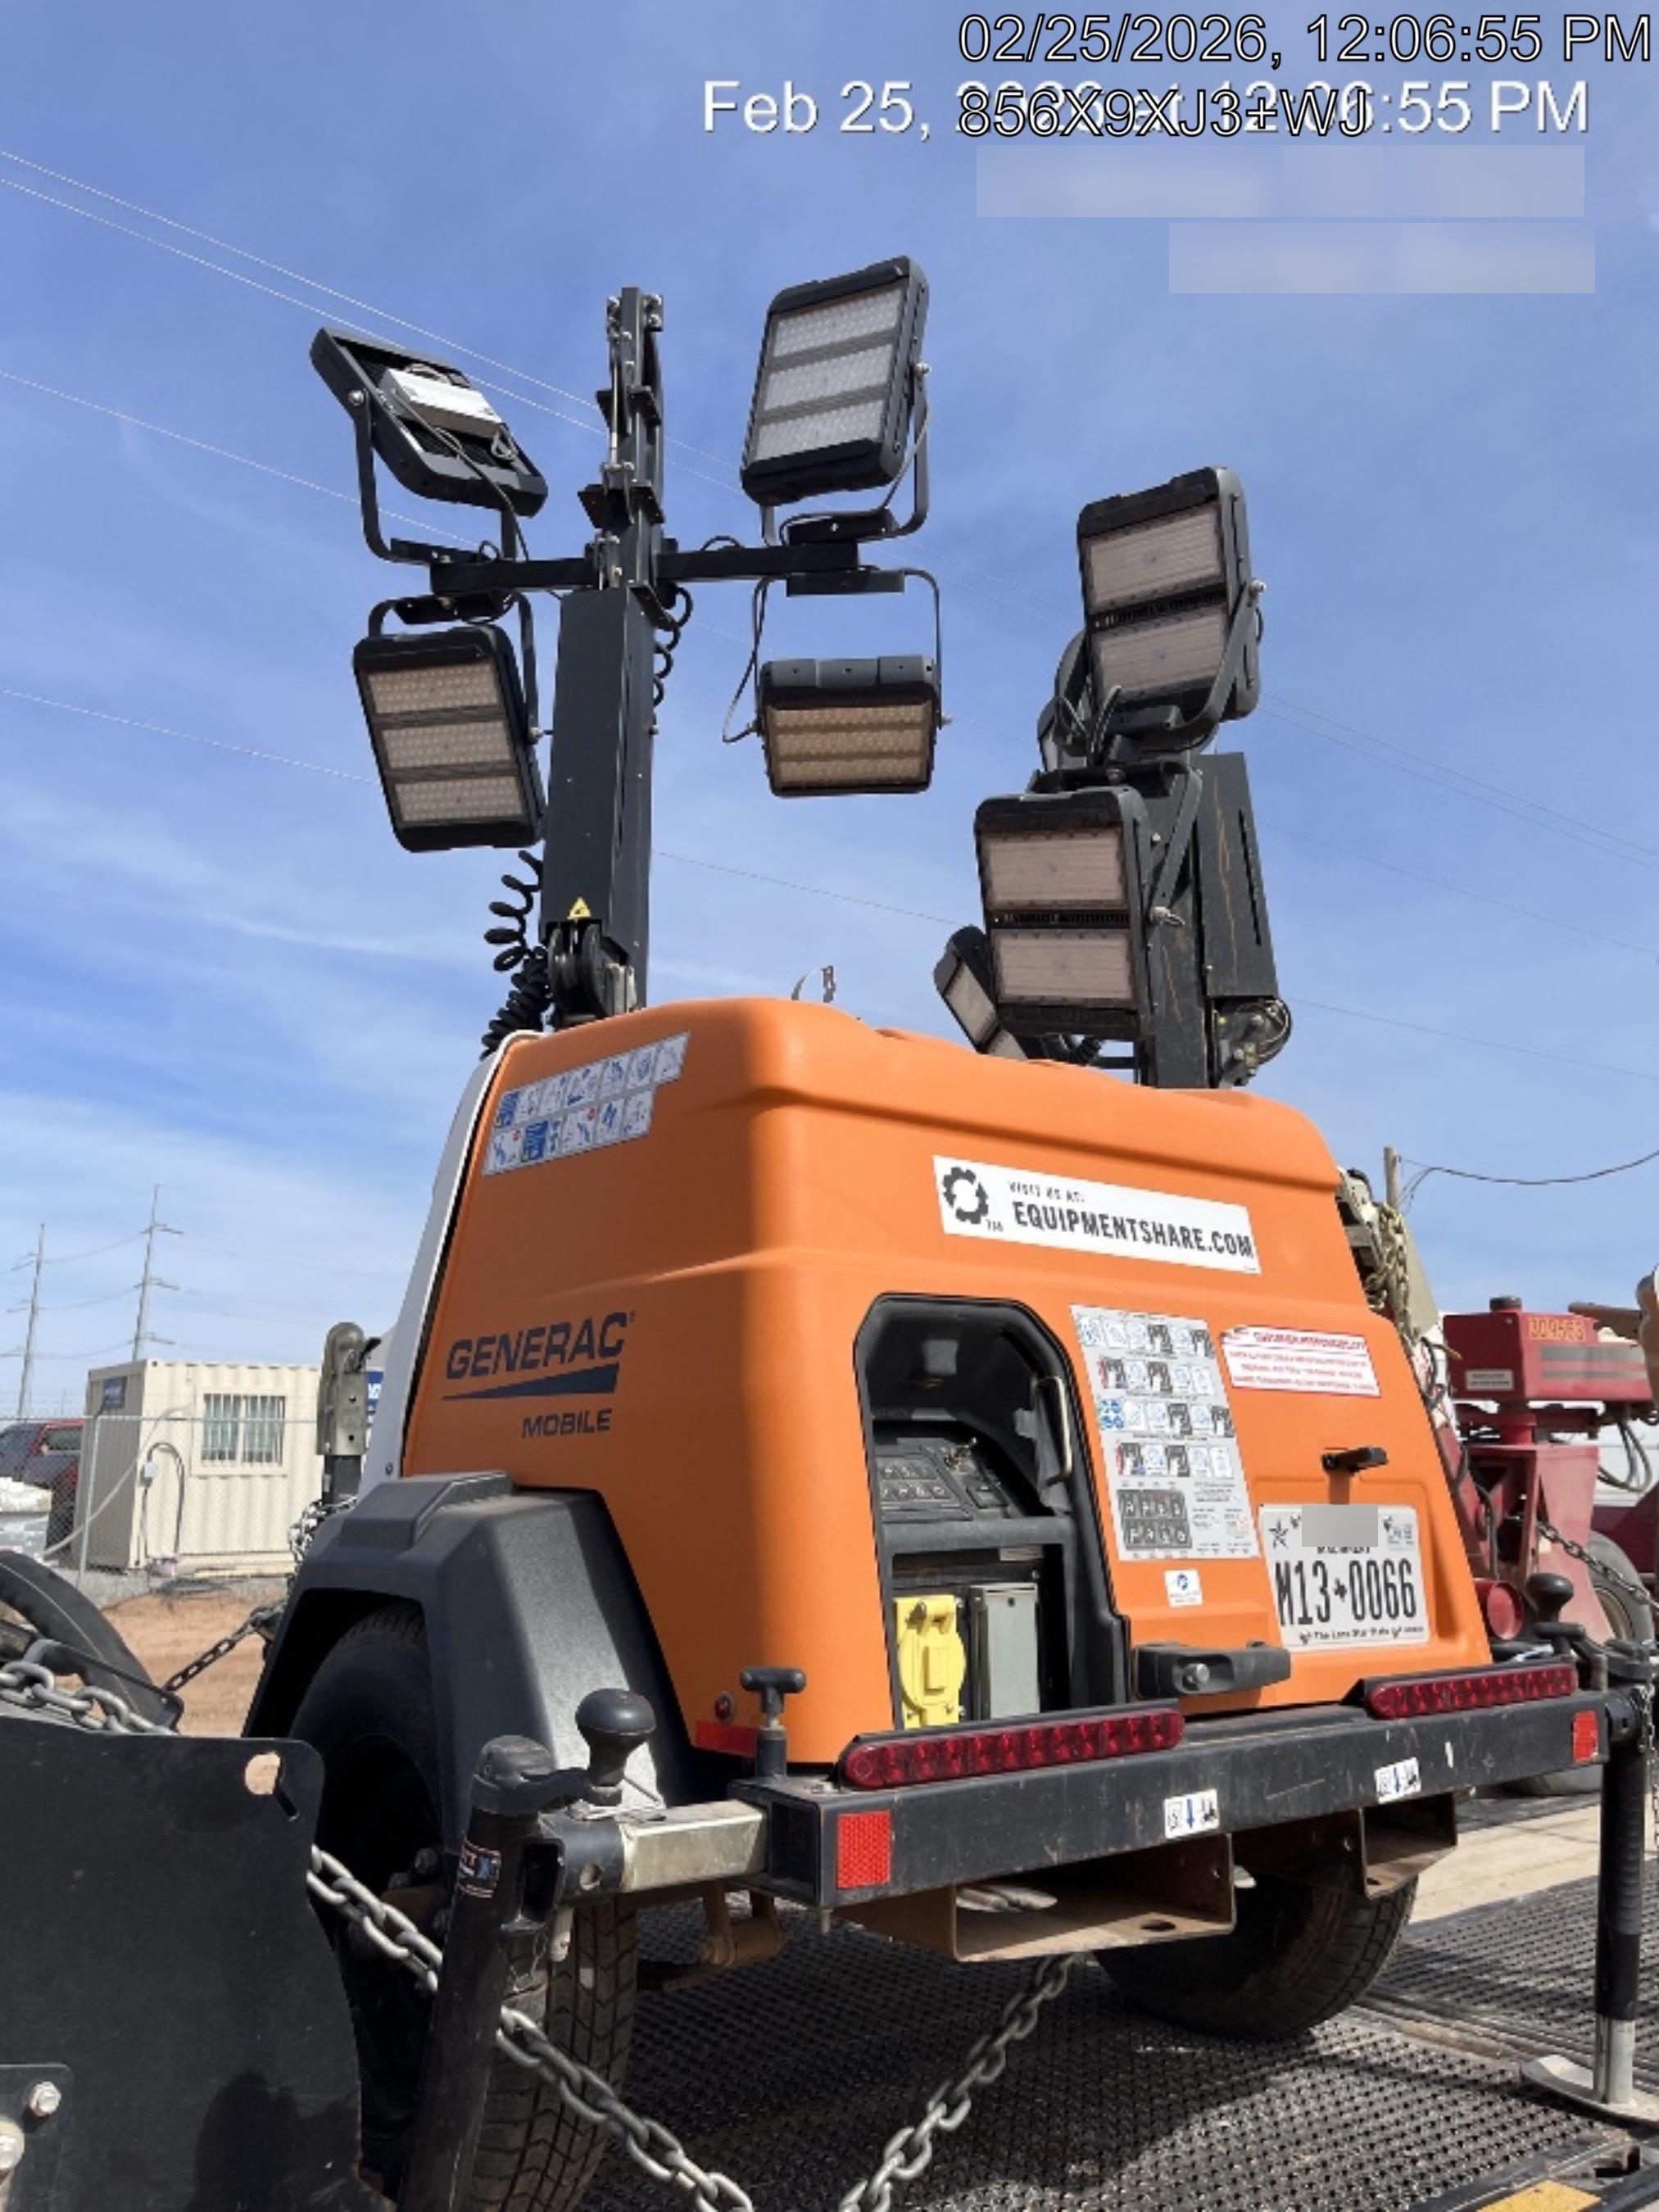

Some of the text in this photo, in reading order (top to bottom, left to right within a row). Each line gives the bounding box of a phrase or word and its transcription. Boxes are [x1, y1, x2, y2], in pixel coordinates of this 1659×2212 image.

[1012, 1201, 1254, 1259] EQUIPMENTSHARE.COM
[446, 1311, 628, 1380] GENERAC
[521, 1408, 613, 1439] MOBILE
